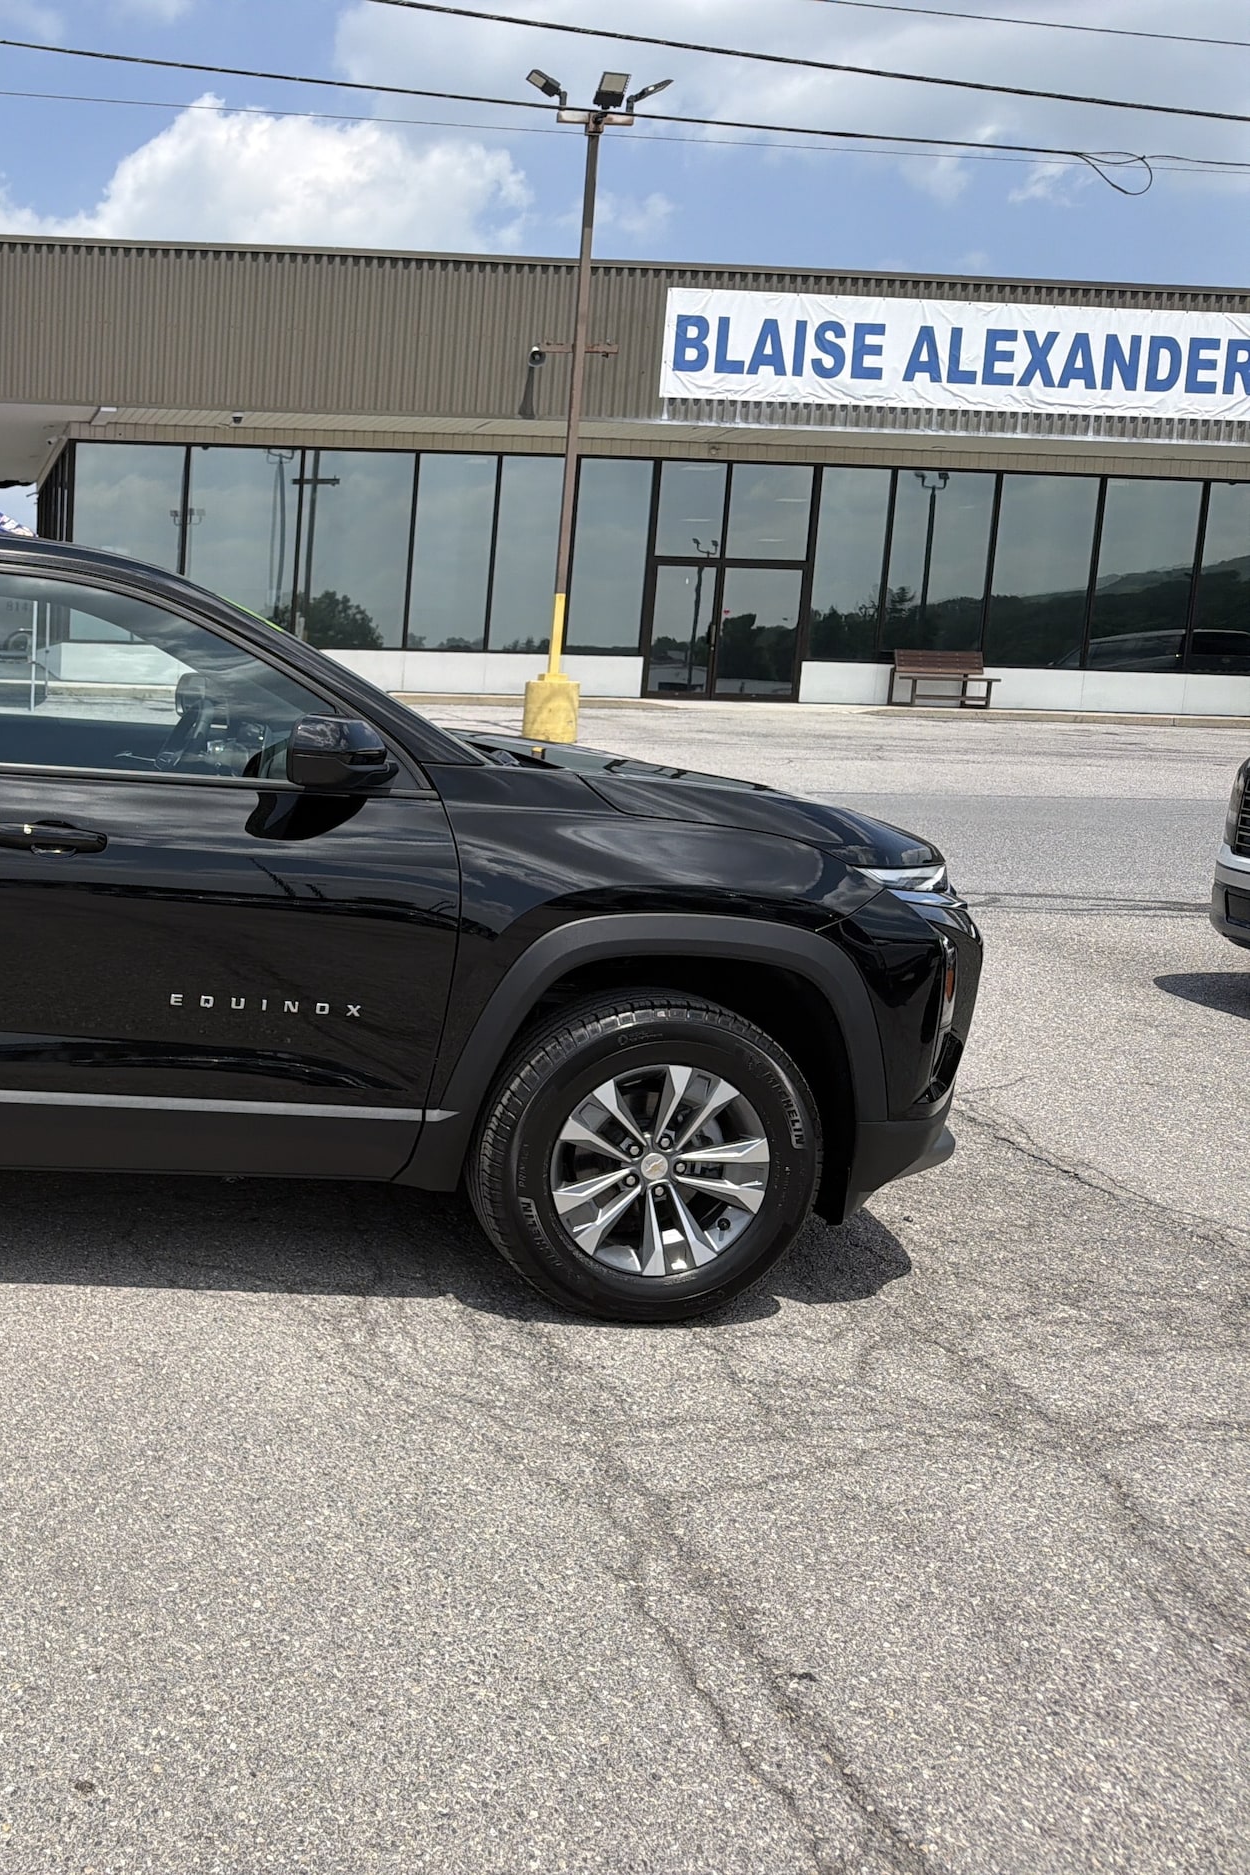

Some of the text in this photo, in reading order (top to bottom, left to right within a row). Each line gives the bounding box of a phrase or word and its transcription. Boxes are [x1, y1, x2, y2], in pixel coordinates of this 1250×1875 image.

[672, 314, 1250, 397] BLAISE ALEXANDER
[168, 992, 363, 1018] EQUINOX
